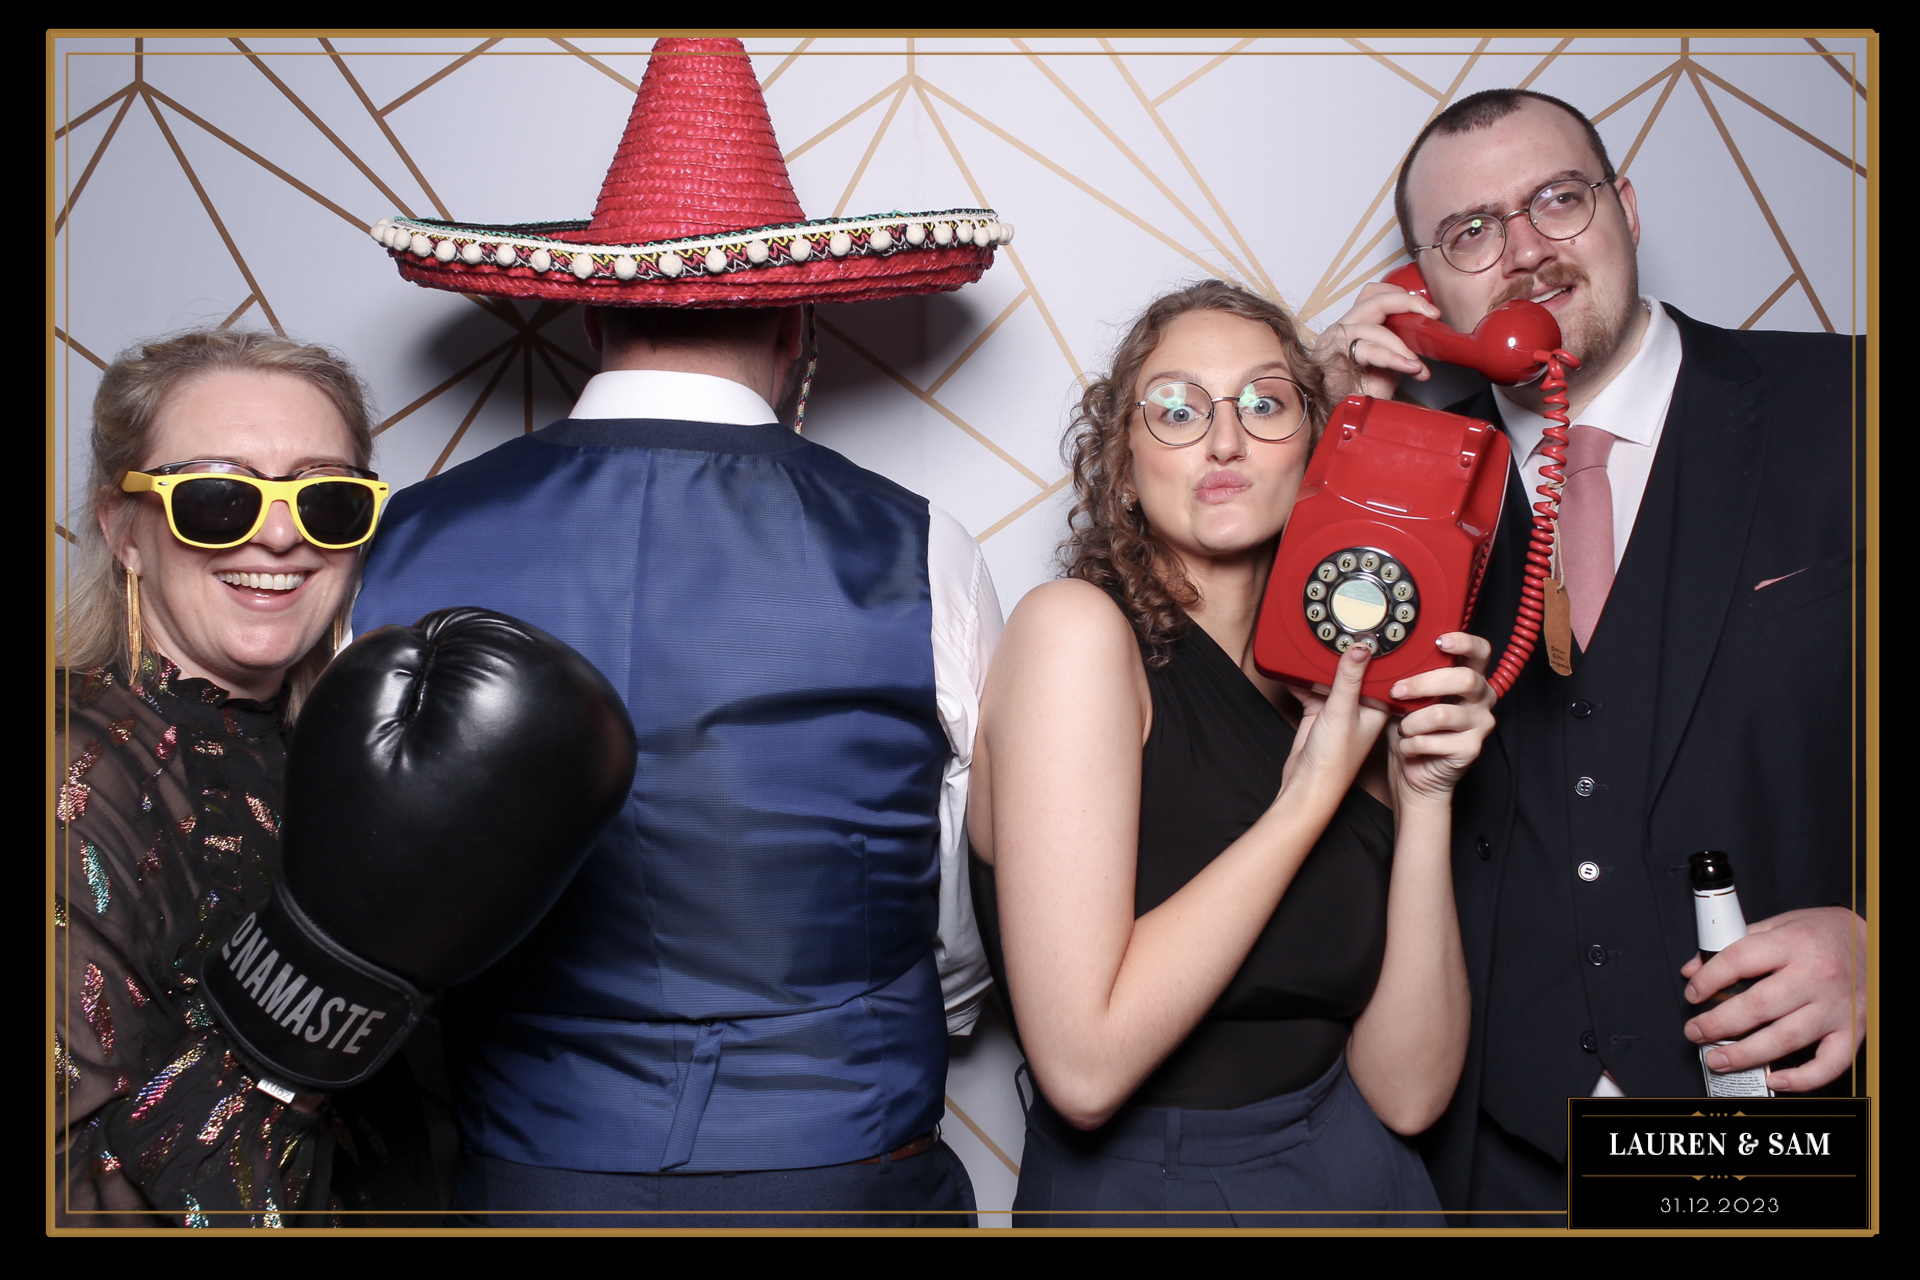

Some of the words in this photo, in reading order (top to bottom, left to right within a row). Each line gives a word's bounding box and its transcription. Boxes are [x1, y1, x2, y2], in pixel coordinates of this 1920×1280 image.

[1342, 558, 1351, 569] 6
[1365, 558, 1373, 568] 5
[1322, 569, 1331, 579] 7
[1384, 569, 1392, 578] 4
[1310, 587, 1319, 597] 8
[1398, 587, 1406, 597] 3
[1310, 609, 1319, 619] 9
[1401, 610, 1409, 620] 2
[1322, 628, 1331, 638] 0
[1391, 628, 1398, 638] 1
